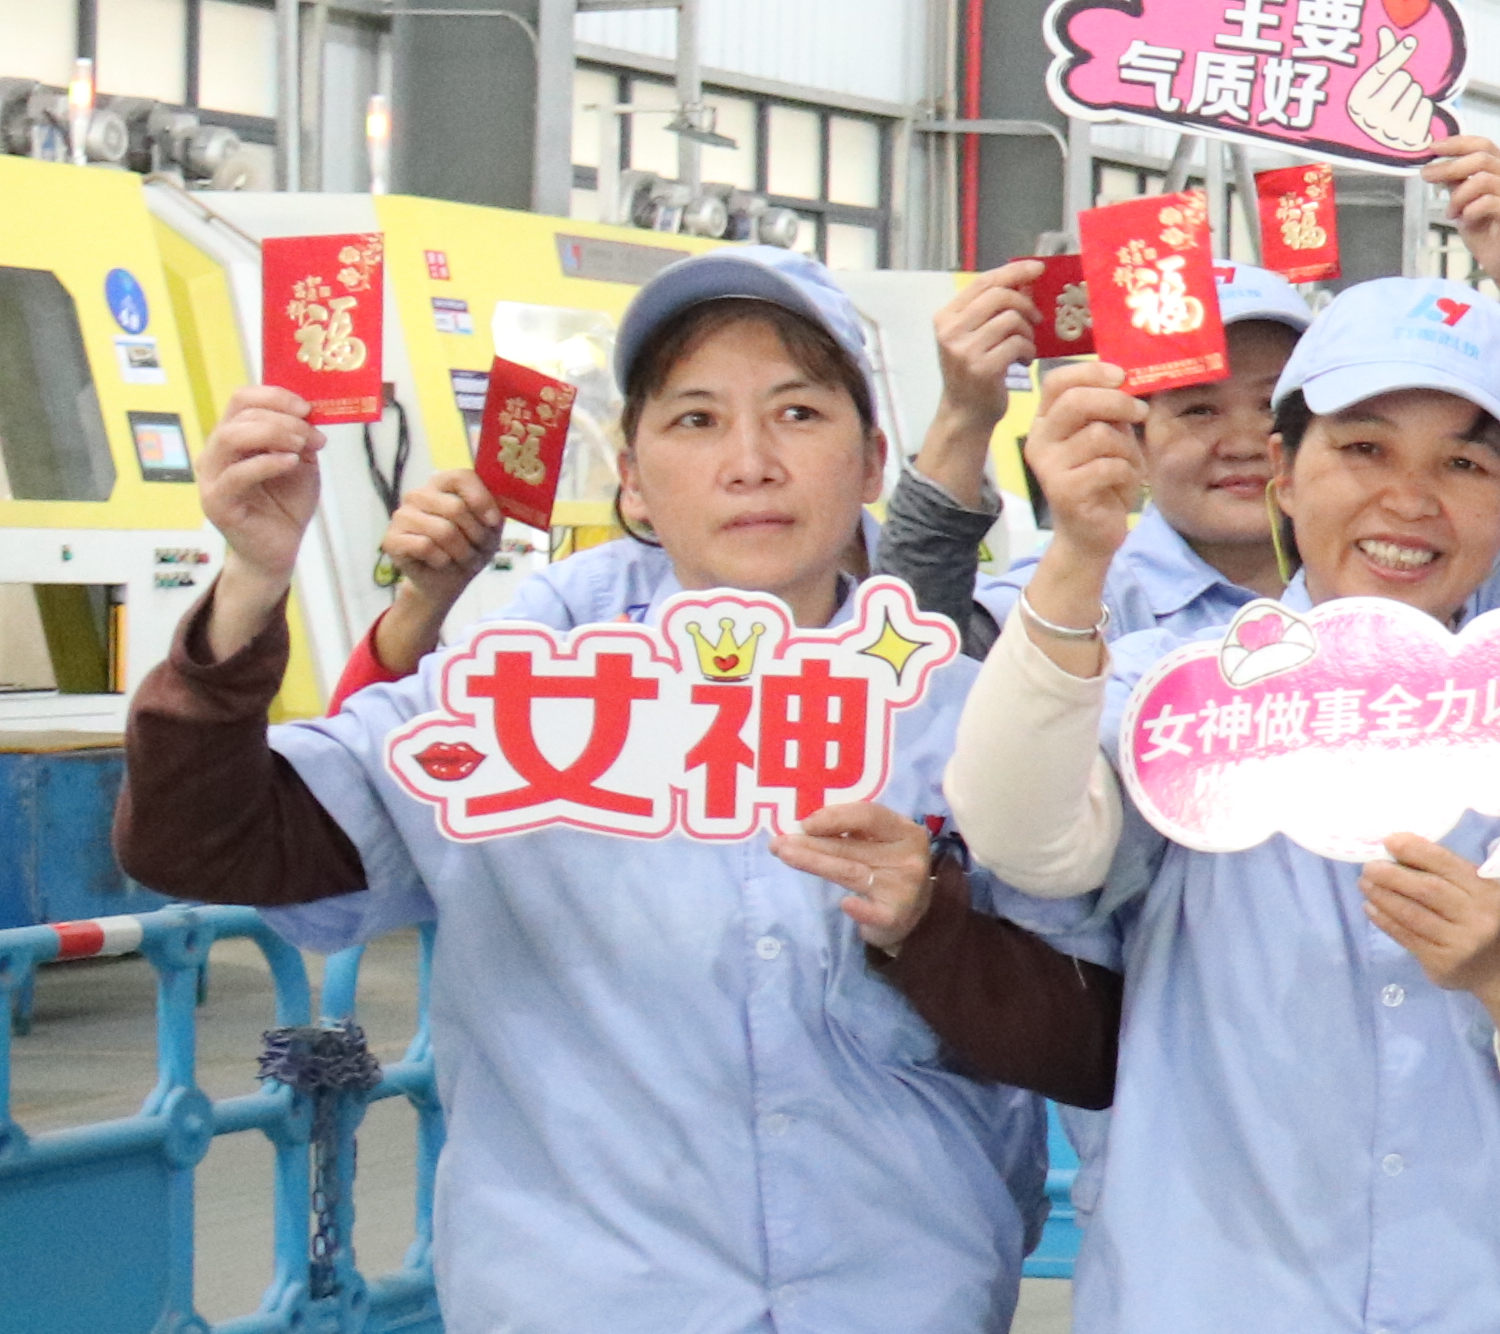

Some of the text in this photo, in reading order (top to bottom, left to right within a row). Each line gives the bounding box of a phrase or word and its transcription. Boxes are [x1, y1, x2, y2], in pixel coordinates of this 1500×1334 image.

[1117, 39, 1329, 130] 气质好
[294, 295, 367, 372] 福
[1126, 254, 1205, 336] 福
[497, 419, 547, 486] 福
[465, 650, 869, 821] 女神
